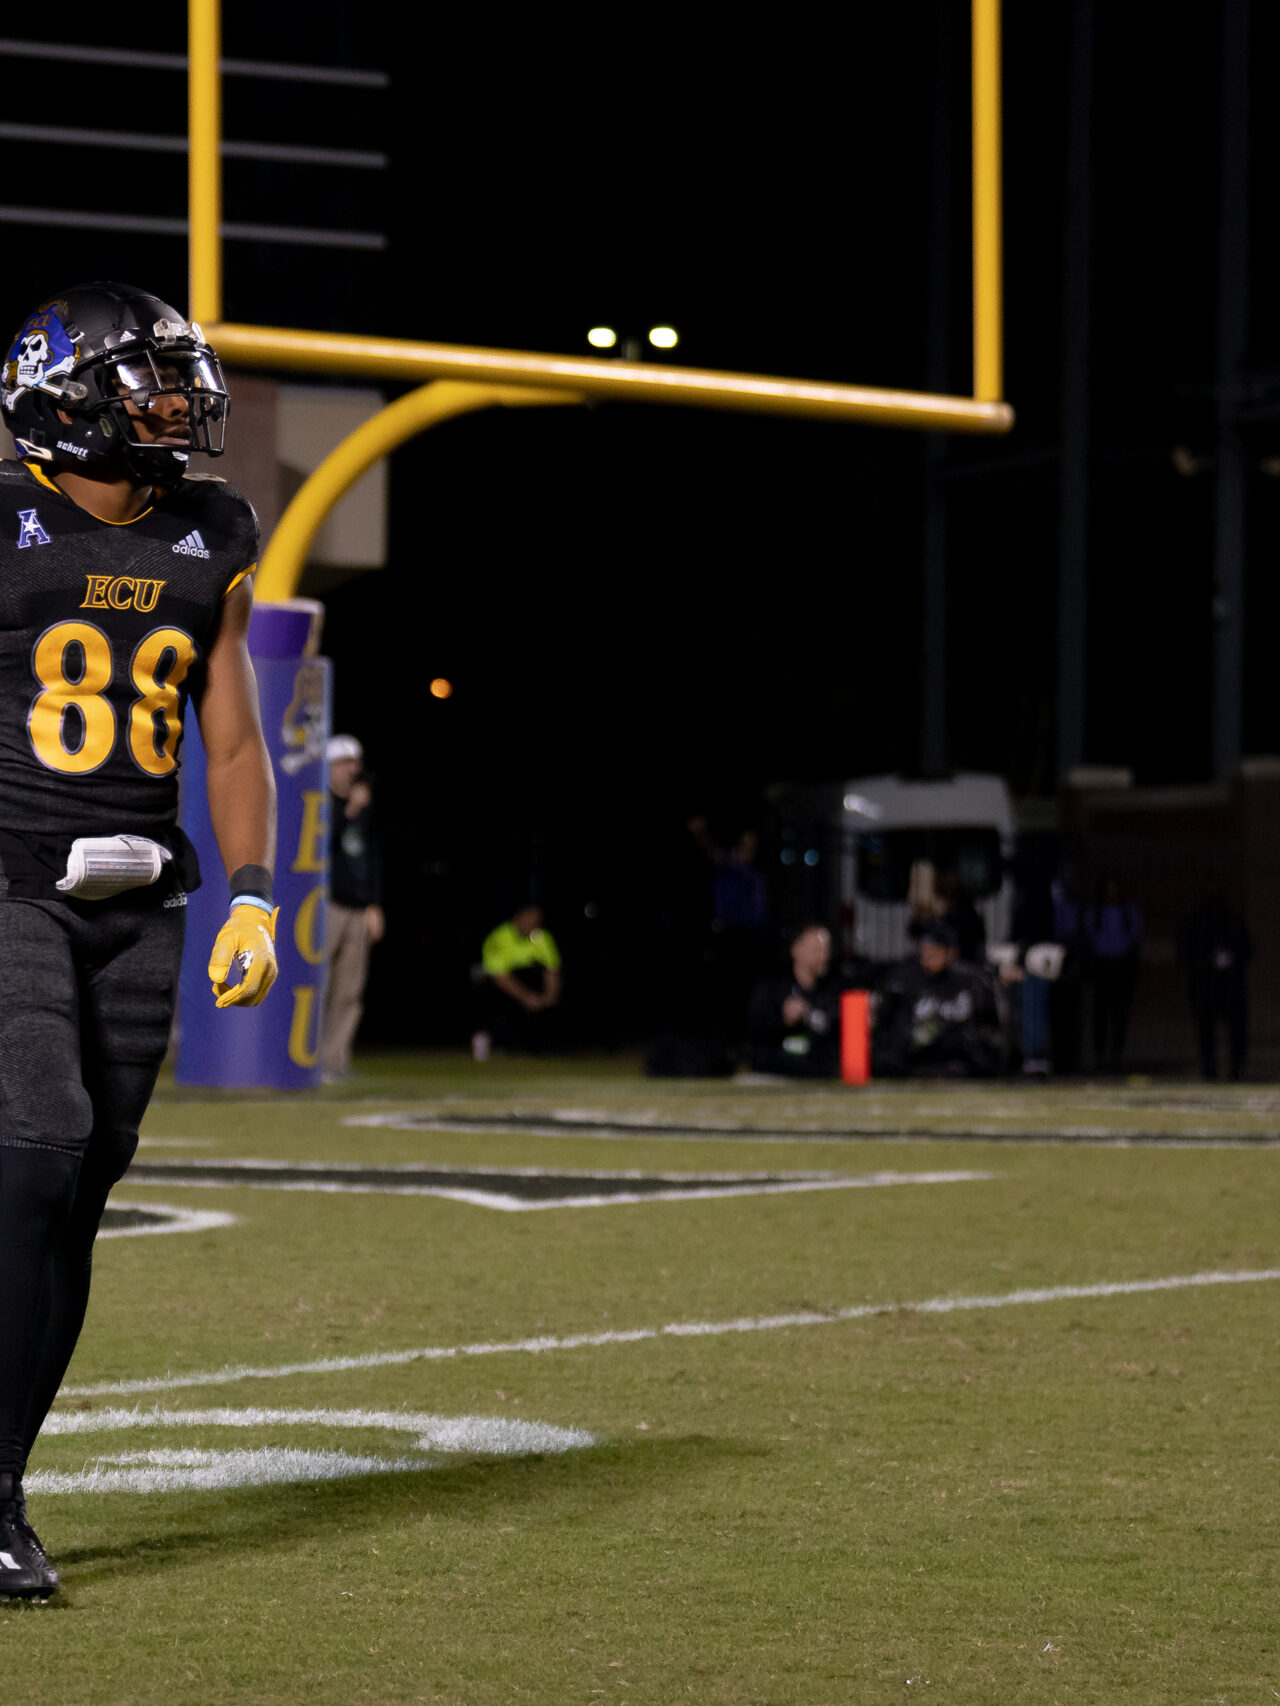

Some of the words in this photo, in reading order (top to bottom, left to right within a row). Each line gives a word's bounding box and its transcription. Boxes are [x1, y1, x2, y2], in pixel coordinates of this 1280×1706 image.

[56, 440, 89, 459] schutt
[172, 542, 211, 560] adidas
[80, 574, 166, 612] ECU
[26, 619, 197, 779] 88
[163, 892, 188, 908] adida
